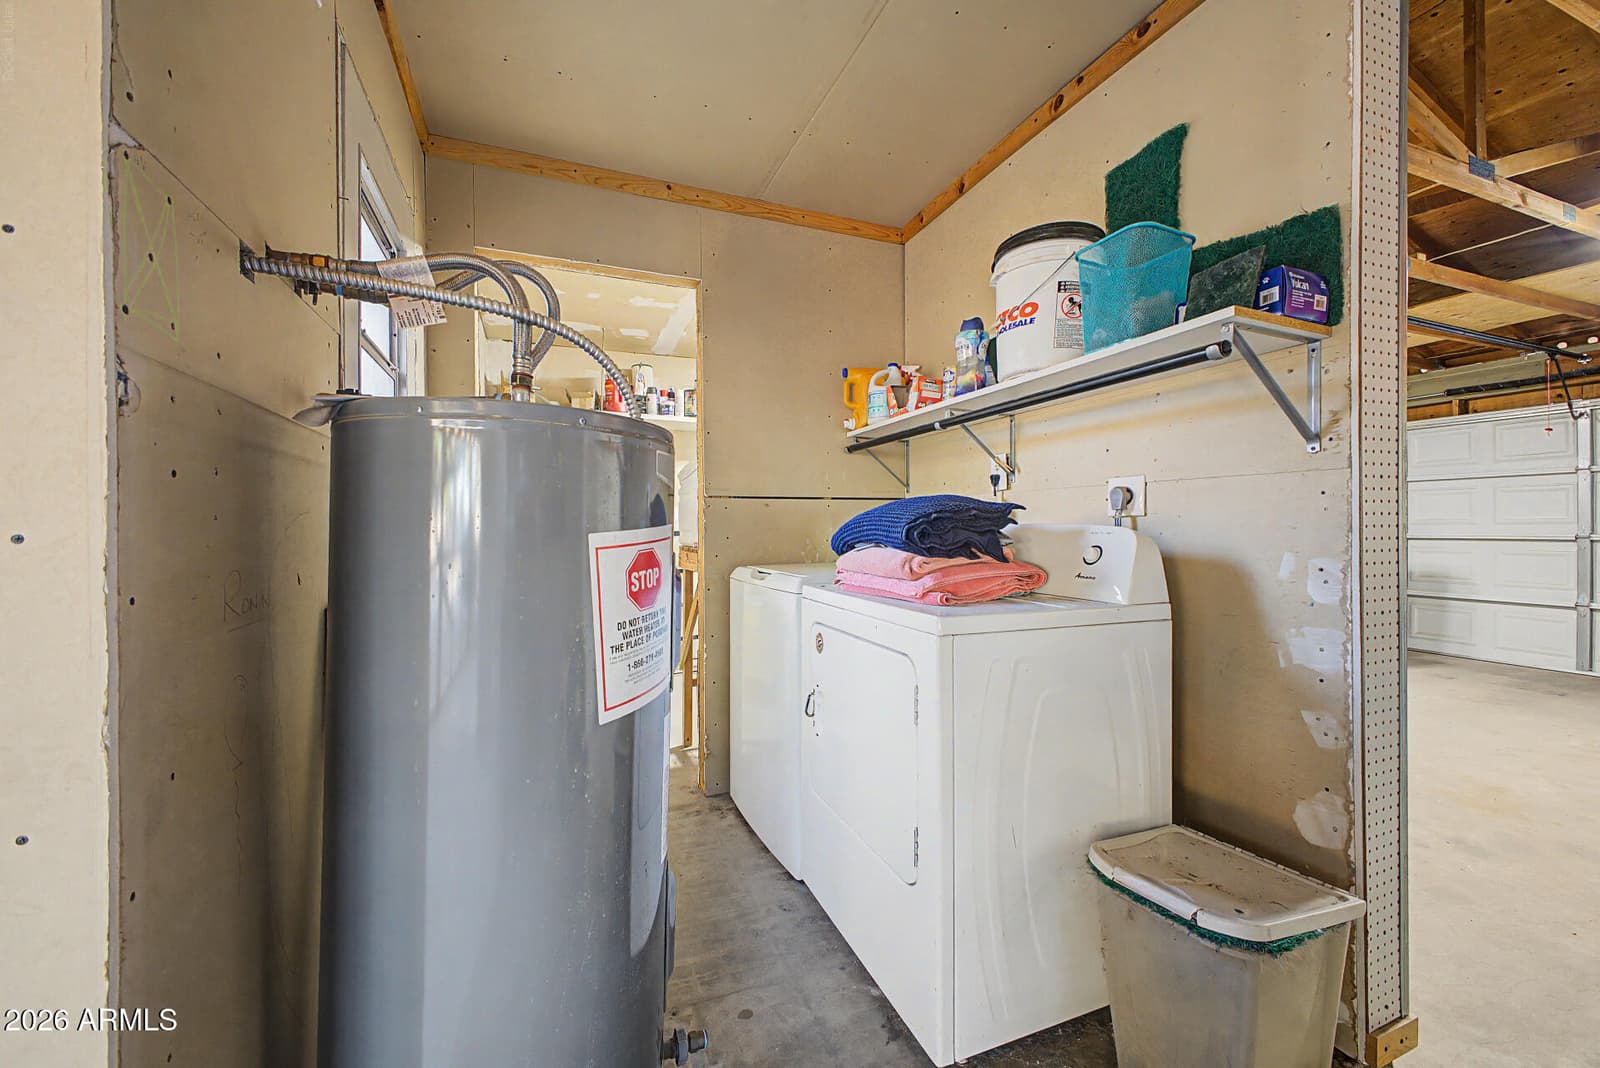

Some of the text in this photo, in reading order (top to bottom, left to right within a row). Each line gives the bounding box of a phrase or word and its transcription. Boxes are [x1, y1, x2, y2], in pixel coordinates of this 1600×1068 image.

[631, 567, 659, 592] STOP
[617, 622, 627, 631] DO
[628, 616, 641, 628] NOT
[622, 627, 644, 641] WATER
[610, 643, 624, 655] THE
[626, 635, 645, 651] PLACE
